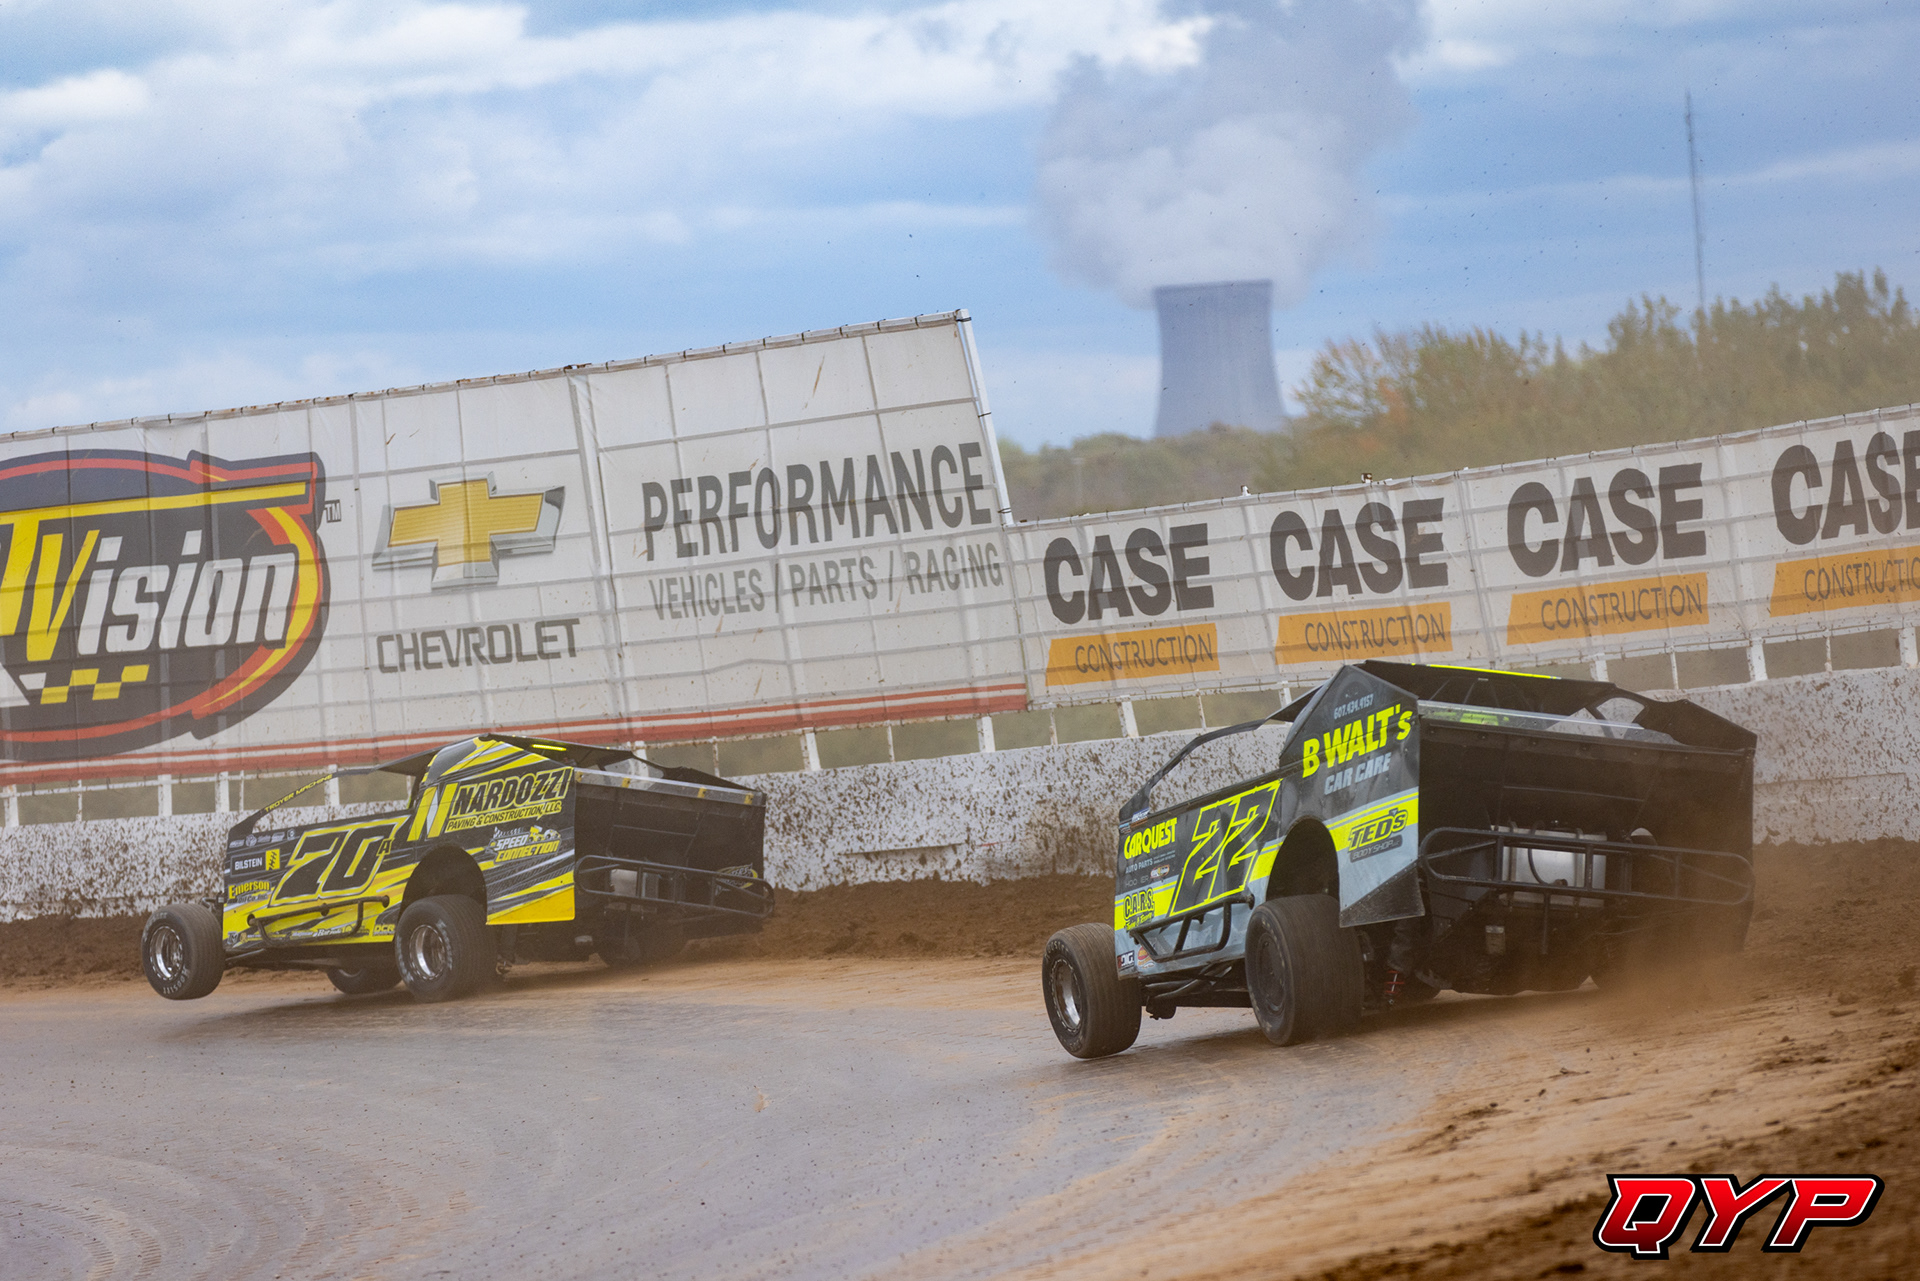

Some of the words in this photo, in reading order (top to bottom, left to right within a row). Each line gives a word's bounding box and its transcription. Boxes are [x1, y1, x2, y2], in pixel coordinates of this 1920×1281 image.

[641, 442, 992, 562] PERFORMANCE
[1507, 462, 1708, 577] CASE
[1269, 498, 1449, 601] CASE
[649, 568, 766, 621] VEHICLES
[789, 555, 878, 607] PARTS
[906, 541, 1005, 596] RACING
[1043, 522, 1216, 625] CASE
[1541, 585, 1703, 631] CONSTRUCTION
[376, 617, 581, 674] CHEVROLET
[1075, 632, 1214, 675] CONSTRUCTION
[1304, 612, 1446, 653] CONSTRUCTION
[1302, 738, 1320, 778] B
[1324, 767, 1353, 795] CAR
[1355, 752, 1392, 784] CARE
[452, 767, 574, 818] NARDOZZI
[446, 816, 476, 831] PAVING
[494, 834, 529, 851] SPEED
[1123, 817, 1177, 859] CARQUEST
[1348, 807, 1408, 853] TED'S
[234, 857, 263, 871] BILSTEIN
[267, 815, 411, 908] 70
[495, 840, 560, 863] CONNECTION
[1125, 863, 1138, 874] AUTO
[1138, 858, 1153, 869] PARTS
[1169, 780, 1282, 917] 22
[228, 880, 270, 900] Emerson
